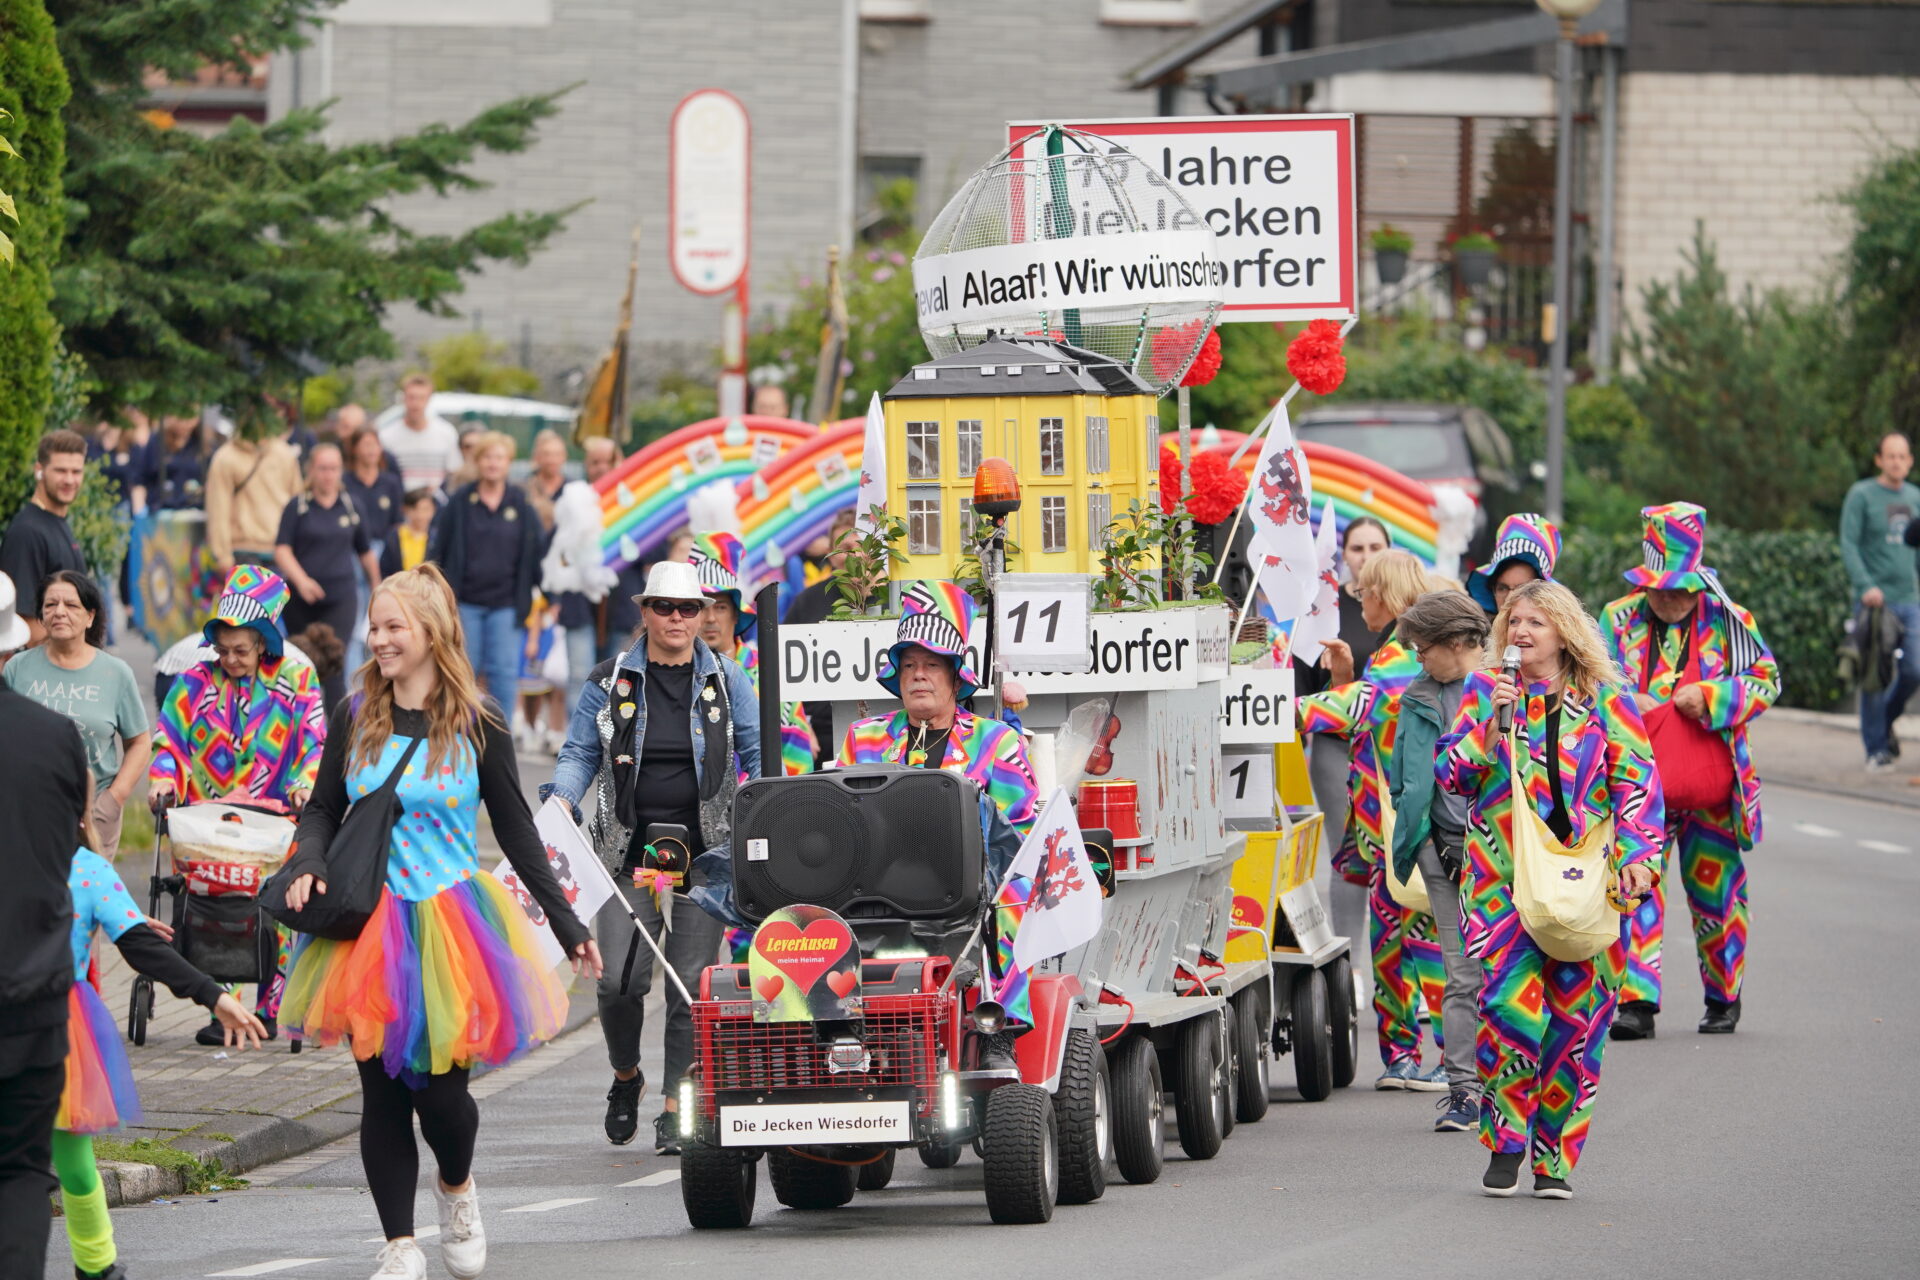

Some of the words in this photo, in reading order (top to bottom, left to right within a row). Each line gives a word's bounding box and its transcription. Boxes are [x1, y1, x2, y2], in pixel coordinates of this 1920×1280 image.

[1146, 145, 1291, 187] Jahre
[1043, 200, 1125, 241] Die
[1140, 197, 1321, 237] Jecken
[914, 274, 949, 317] eval
[962, 262, 1049, 309] Alaaf!
[1054, 257, 1114, 296] Wir
[1007, 599, 1062, 644] 11
[784, 638, 842, 684] Die
[25, 679, 101, 702] MAKE
[1220, 683, 1287, 727] rfer
[194, 864, 255, 887] ALLES
[766, 936, 838, 952] Leverkusen
[800, 956, 825, 964] Heimat
[733, 1119, 756, 1133] Die
[761, 1118, 813, 1132] Jecken
[818, 1115, 899, 1130] Wiesdorfer
